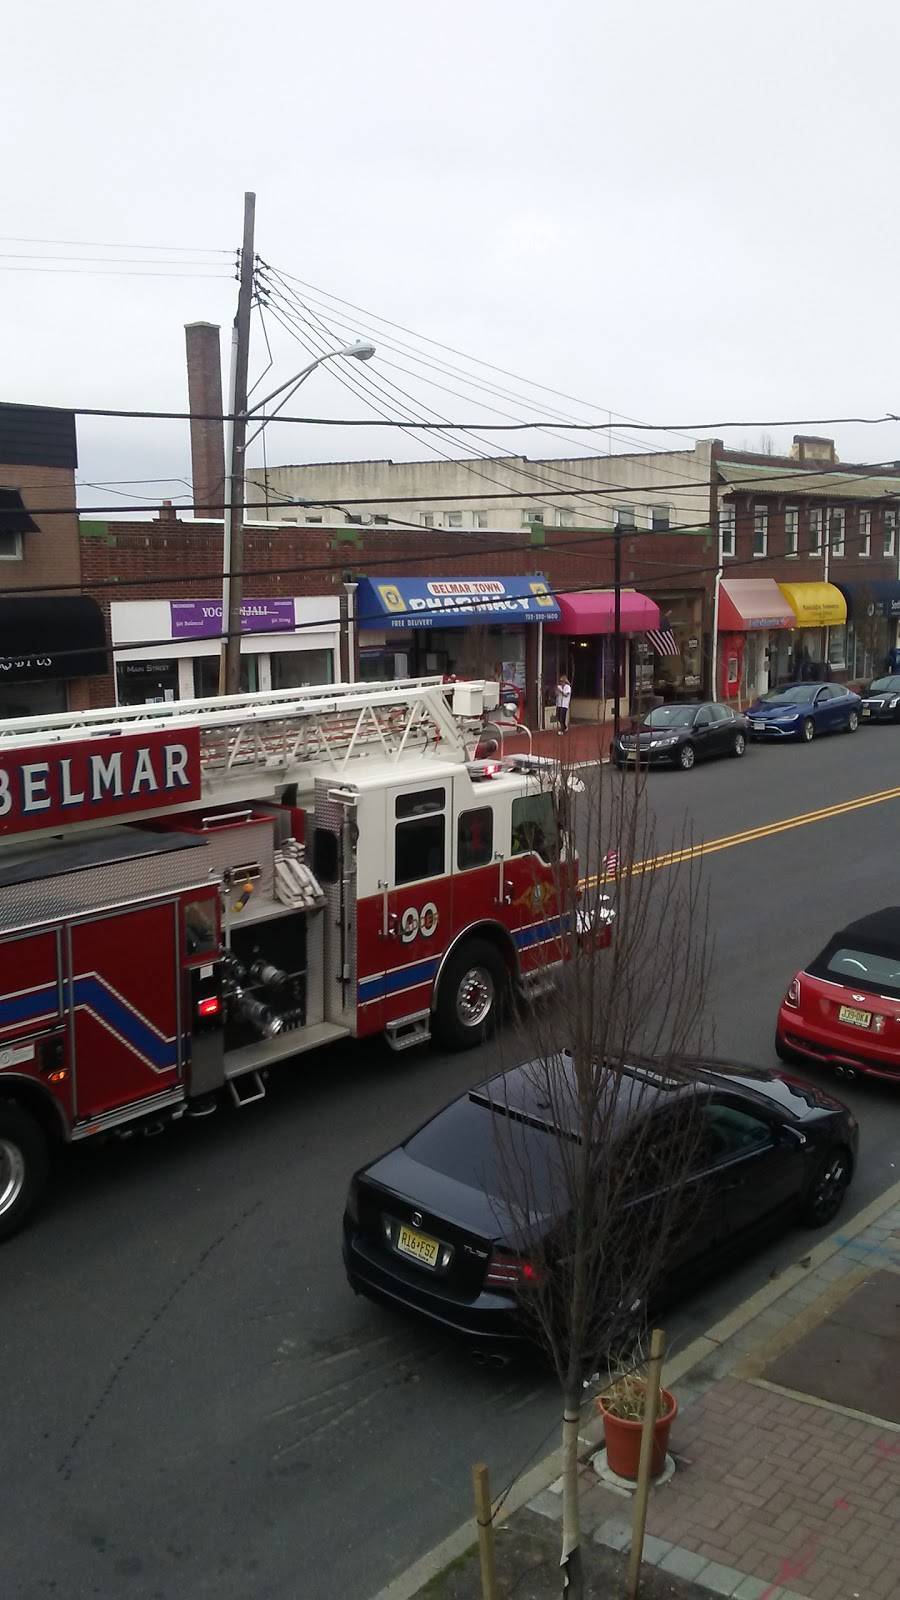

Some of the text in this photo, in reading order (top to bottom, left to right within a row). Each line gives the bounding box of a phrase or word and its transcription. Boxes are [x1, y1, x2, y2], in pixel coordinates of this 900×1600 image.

[432, 583, 501, 594] BELMAR TOWN
[408, 595, 530, 614] PHARMACY
[391, 618, 433, 627] FREE DELIVERY
[401, 902, 438, 943] 90
